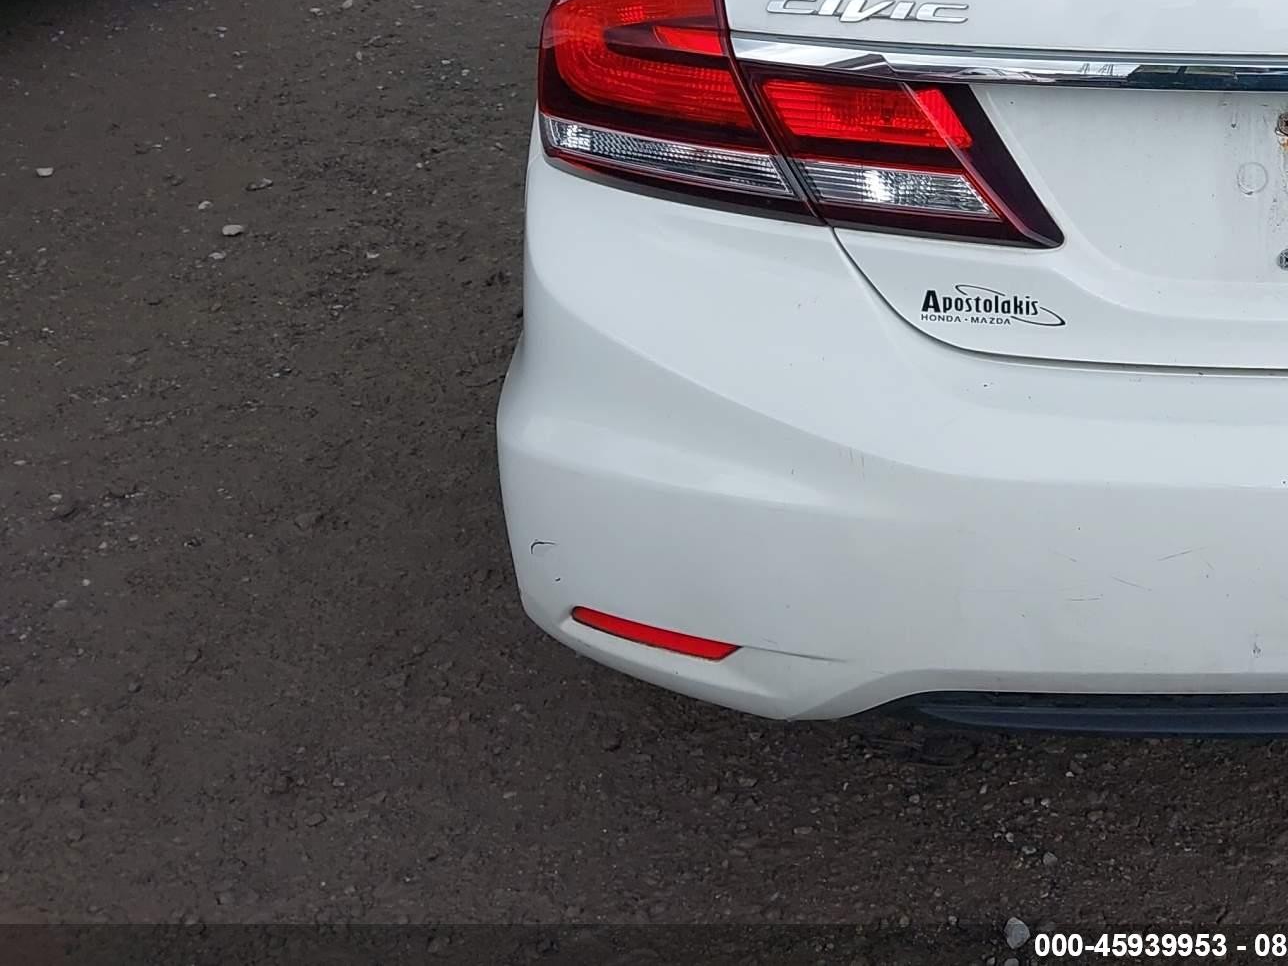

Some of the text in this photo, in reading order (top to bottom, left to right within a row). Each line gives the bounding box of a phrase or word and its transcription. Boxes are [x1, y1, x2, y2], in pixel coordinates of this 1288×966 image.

[921, 289, 1039, 316] Apostolakis
[921, 313, 1011, 325] HONDA MAZDA
